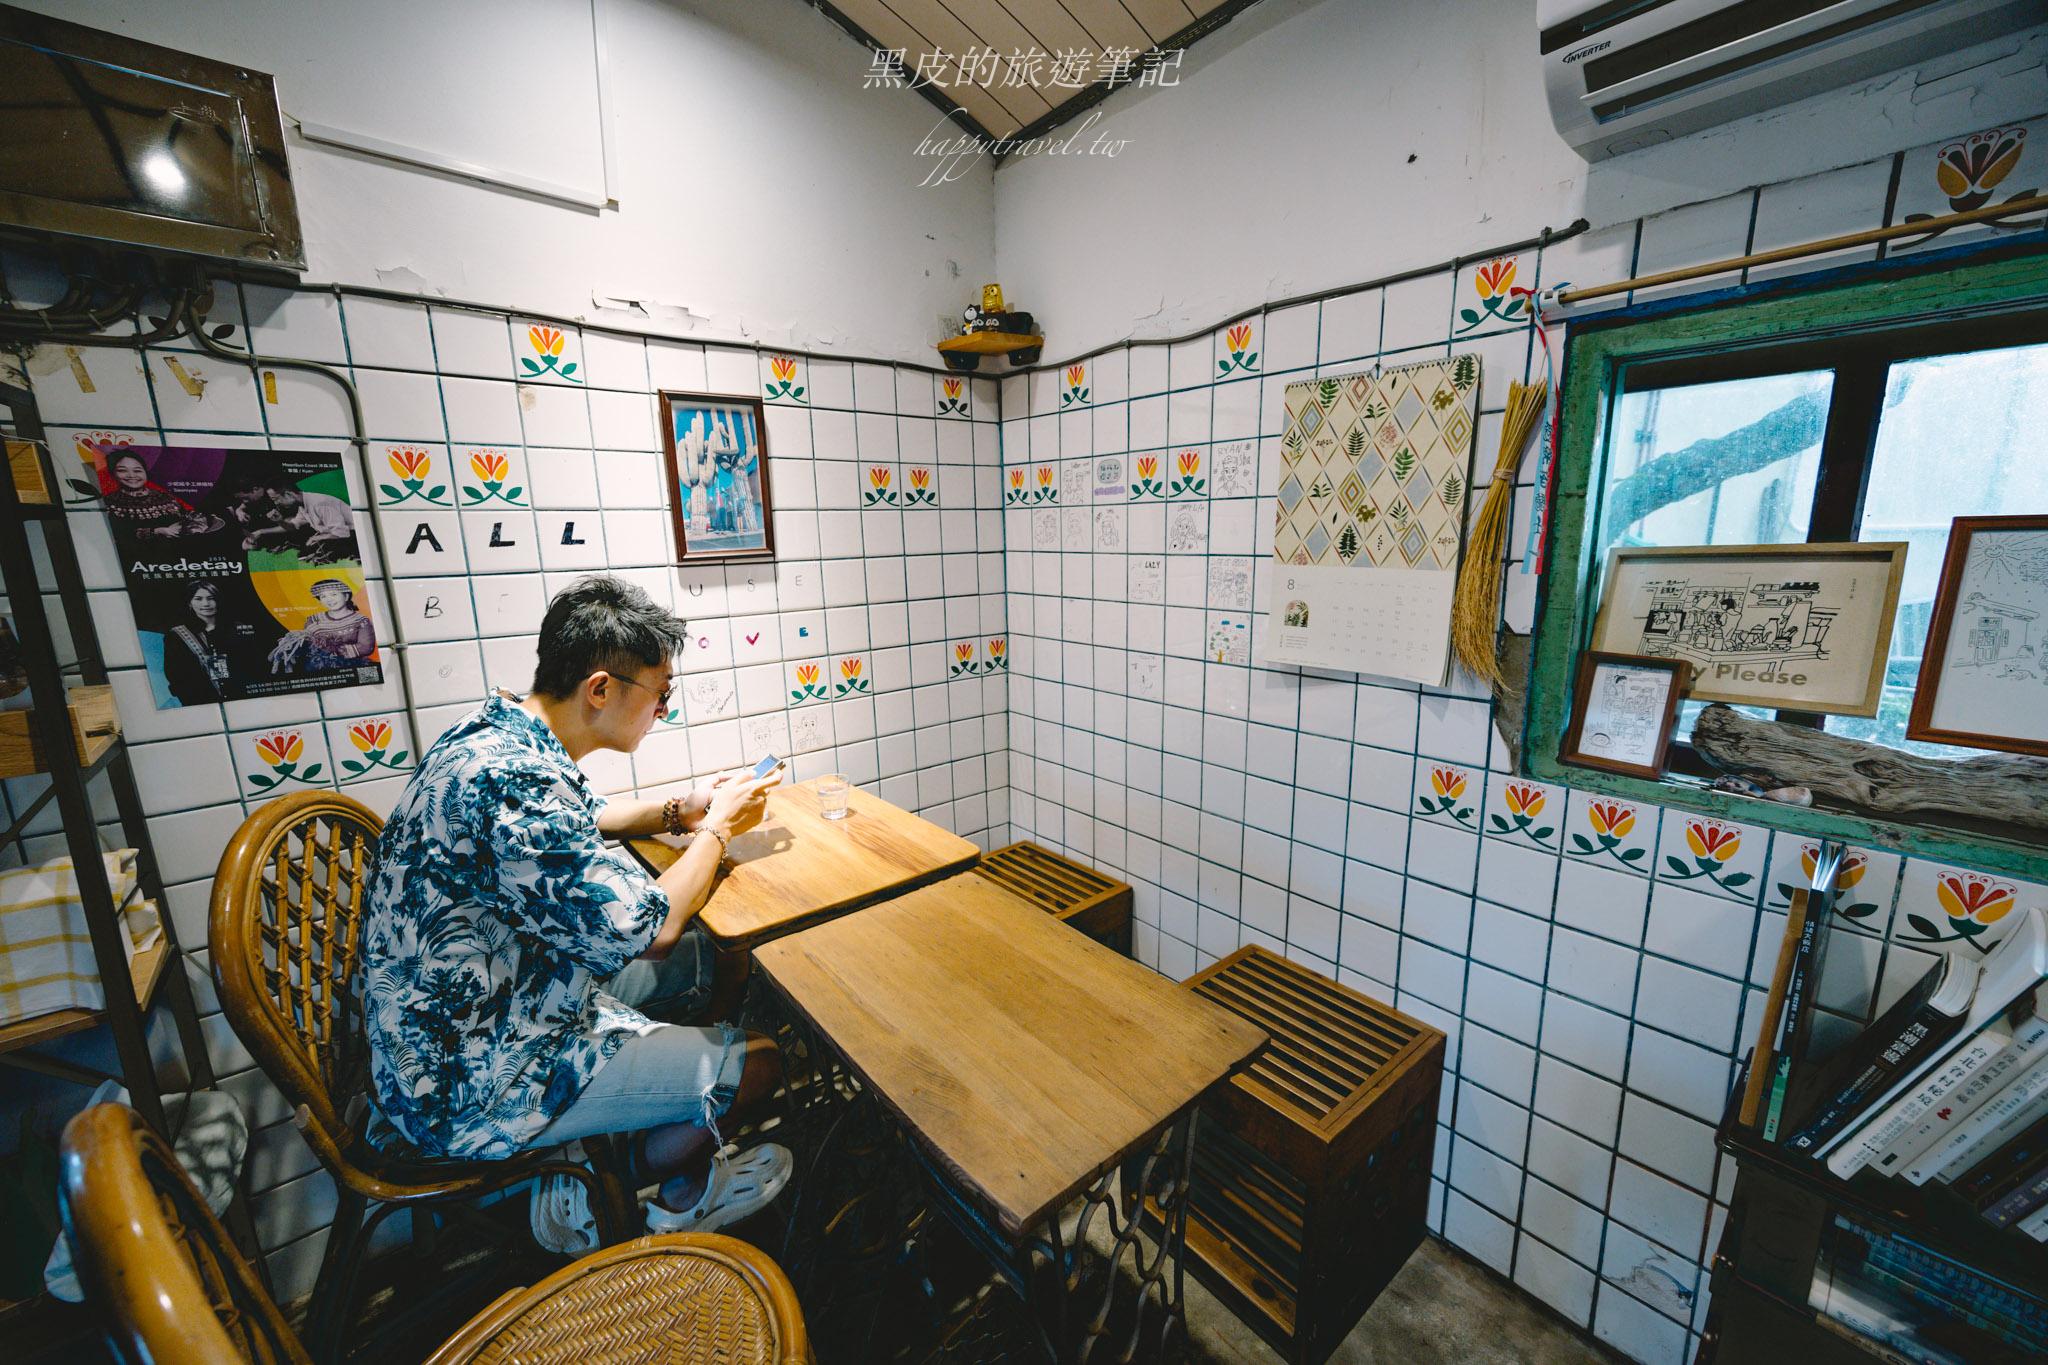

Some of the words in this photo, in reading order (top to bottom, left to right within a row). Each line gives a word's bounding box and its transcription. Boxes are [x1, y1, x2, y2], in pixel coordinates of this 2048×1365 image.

[1566, 40, 1611, 64] INVERTER
[131, 558, 243, 574] Aredetay
[1287, 578, 1295, 591] 8
[1716, 664, 1808, 686] Please
